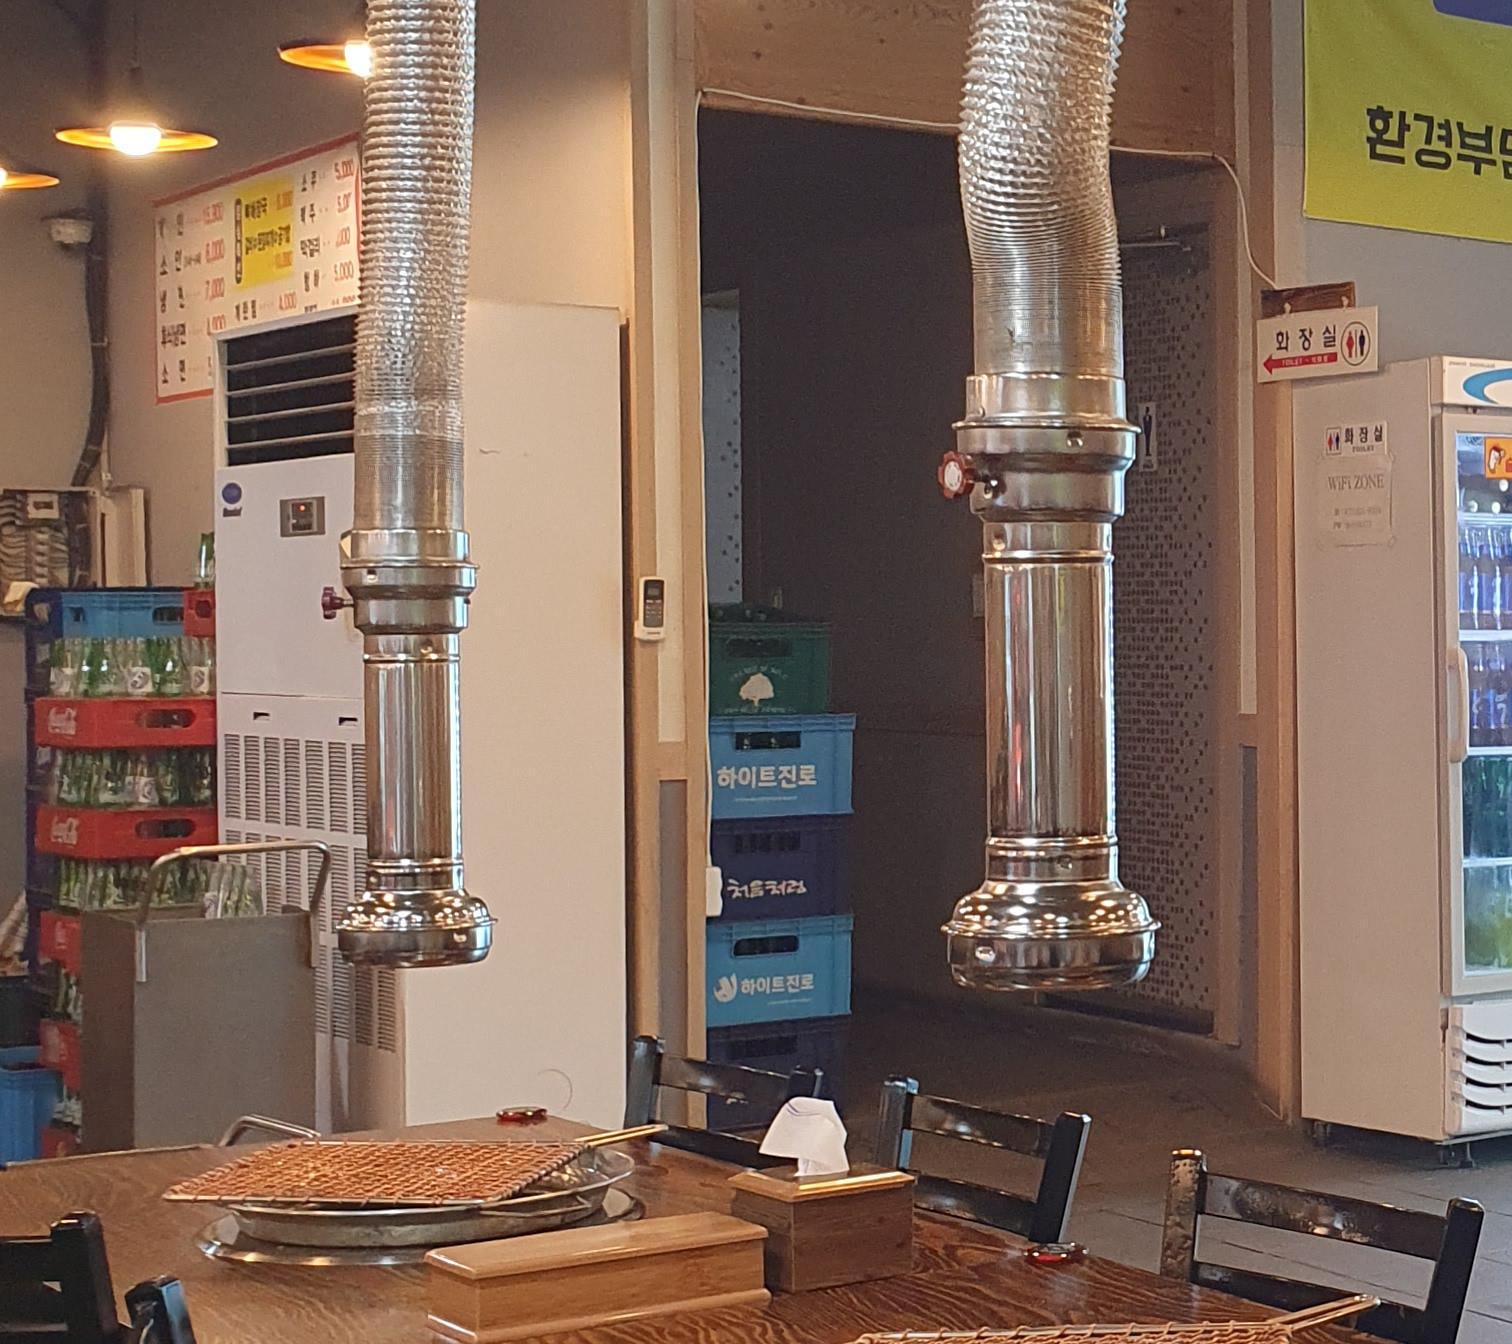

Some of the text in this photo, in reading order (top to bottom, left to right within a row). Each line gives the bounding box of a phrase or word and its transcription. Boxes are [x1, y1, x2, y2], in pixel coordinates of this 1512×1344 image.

[1276, 324, 1337, 352] 화장실
[1344, 426, 1383, 445] 화장실
[717, 764, 818, 790] 하이트진로
[727, 878, 808, 899] 처음처럼
[741, 973, 815, 996] 하이트진로
